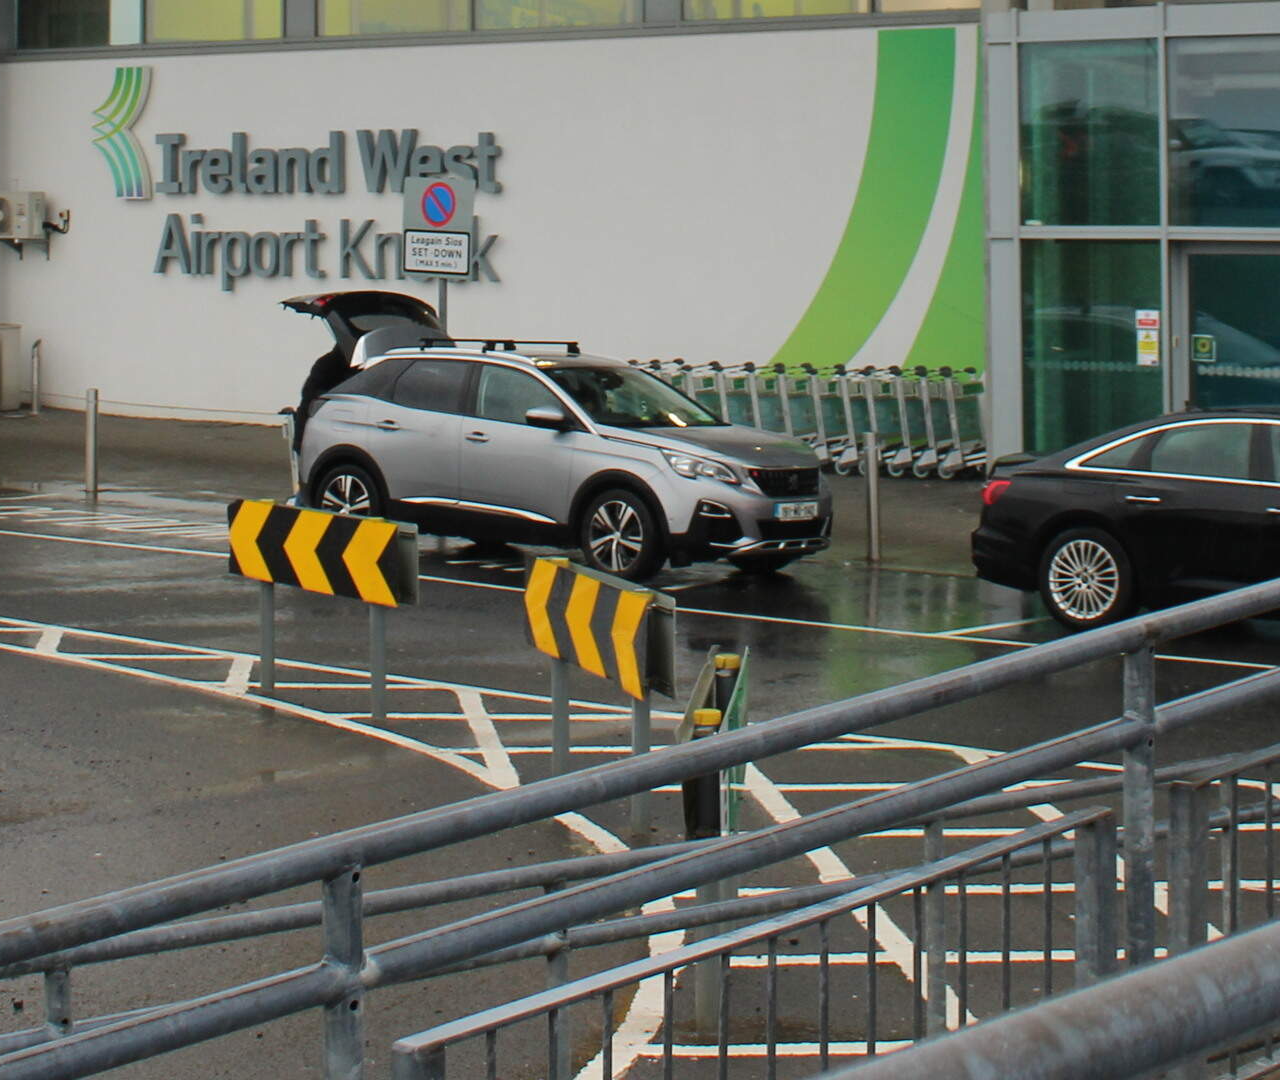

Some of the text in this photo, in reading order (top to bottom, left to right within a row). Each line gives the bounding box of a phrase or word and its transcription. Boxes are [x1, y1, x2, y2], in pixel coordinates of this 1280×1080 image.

[155, 128, 503, 195] Ireland West
[153, 212, 501, 292] Airport Knk
